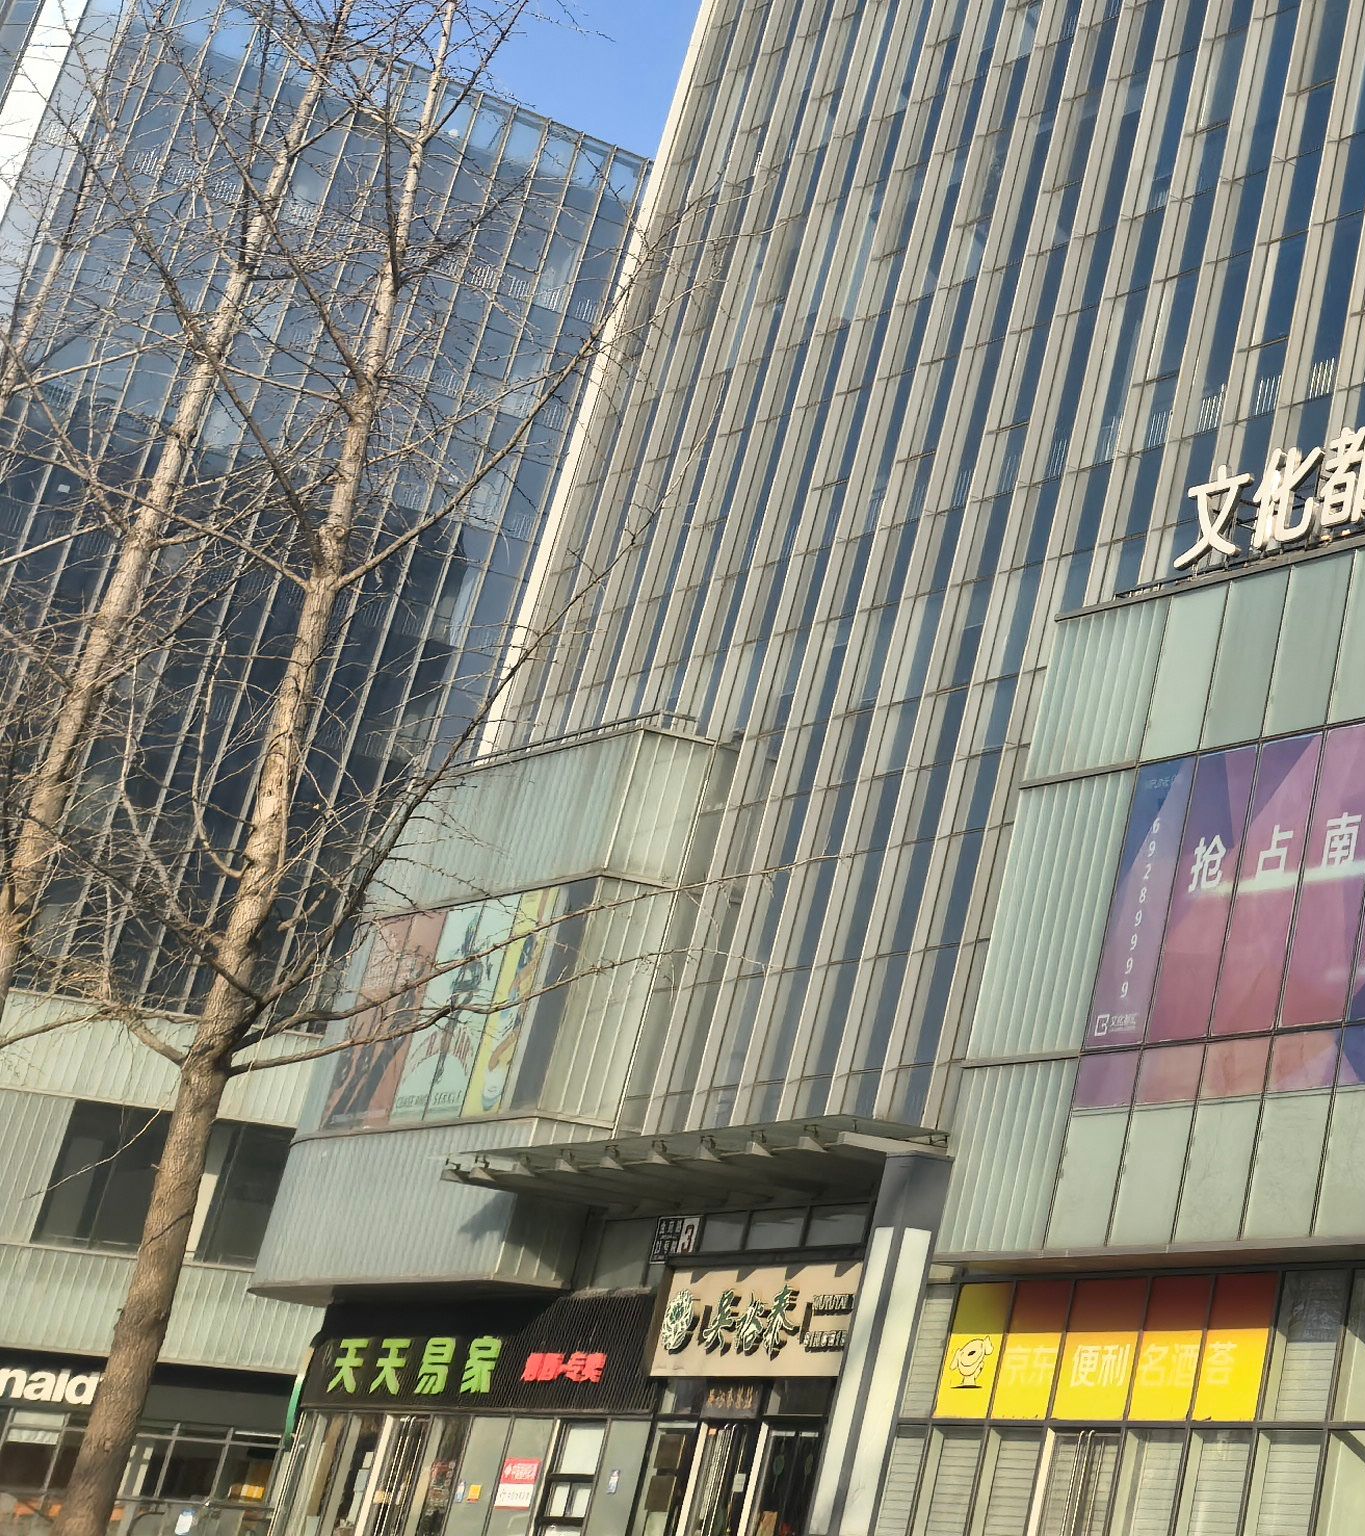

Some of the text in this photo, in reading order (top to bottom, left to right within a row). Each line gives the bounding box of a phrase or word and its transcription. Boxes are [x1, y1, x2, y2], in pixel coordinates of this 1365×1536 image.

[1120, 816, 1161, 999] 69289999
[681, 1224, 695, 1254] 3
[326, 1335, 503, 1395] 天天易家
